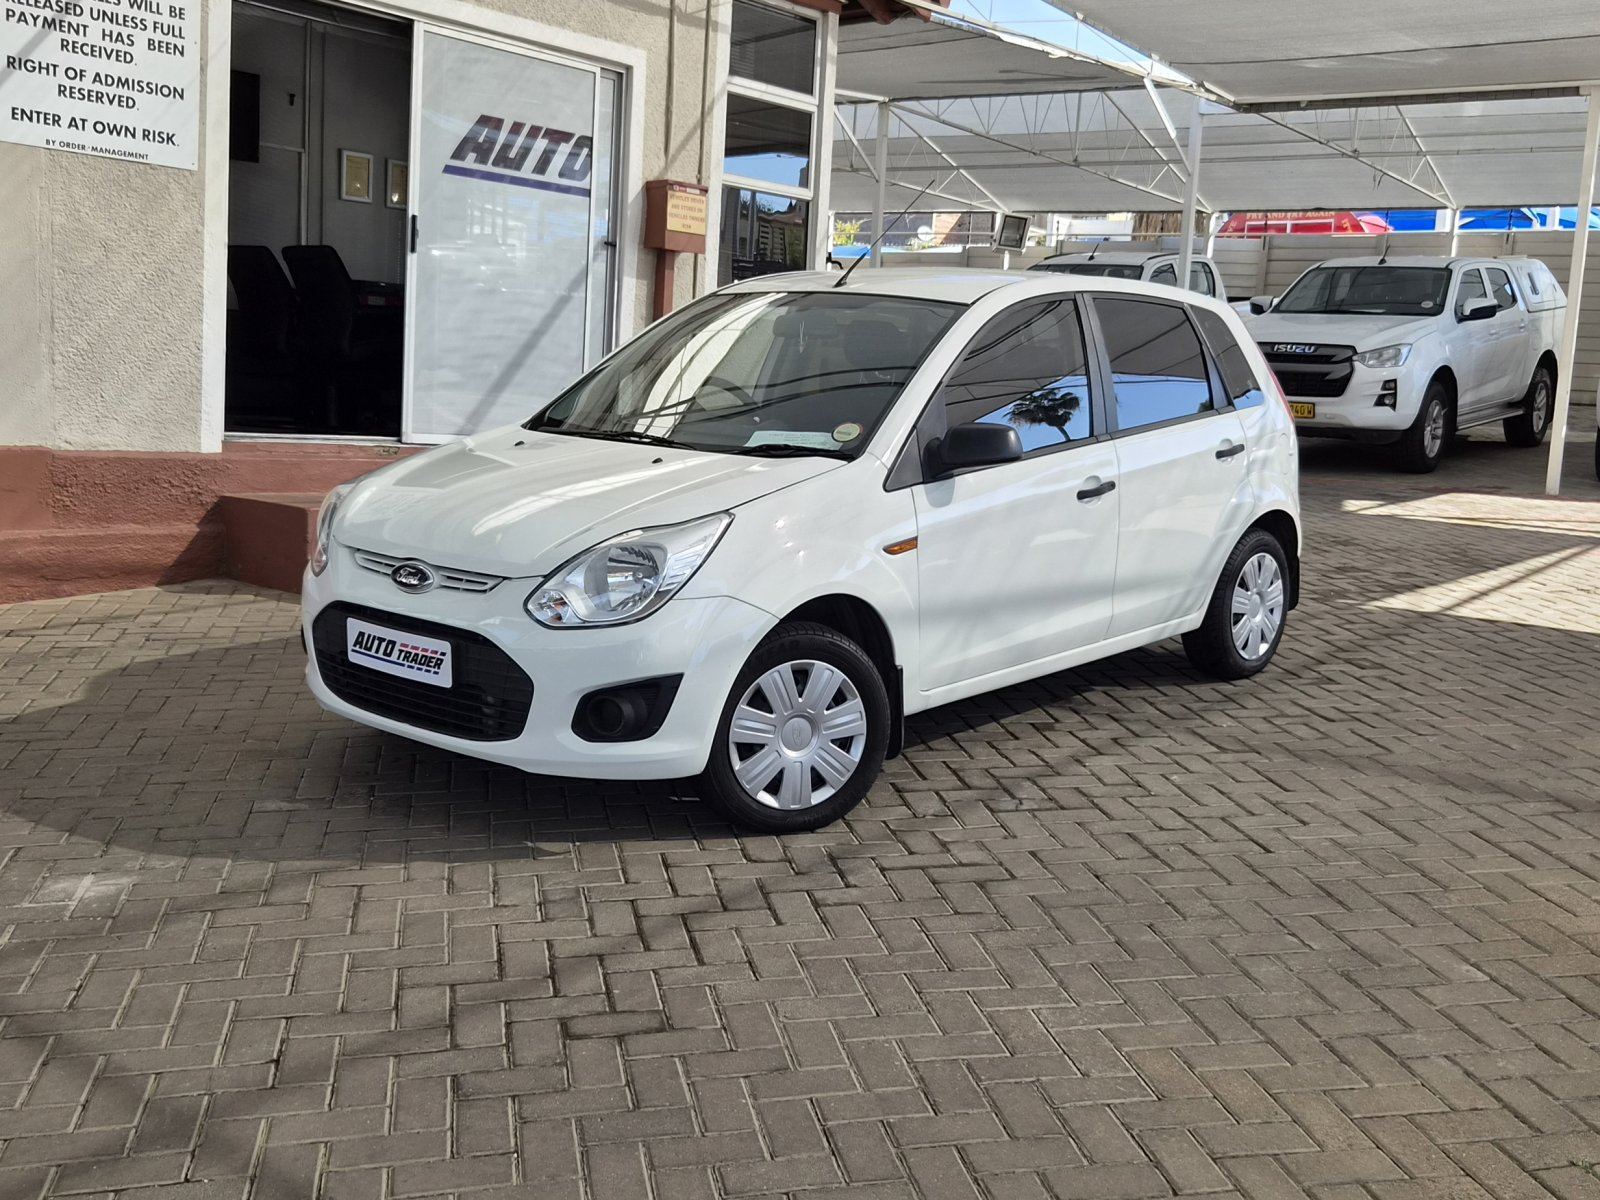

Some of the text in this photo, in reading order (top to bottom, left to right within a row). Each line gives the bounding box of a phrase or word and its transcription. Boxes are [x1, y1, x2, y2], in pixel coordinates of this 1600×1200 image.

[90, 7, 147, 31] UNLESS
[153, 21, 185, 40] FULL
[127, 0, 185, 20] WILL BE
[6, 8, 185, 57] PAYMENT HAS BEEN
[60, 38, 137, 66] RECEIVED.
[7, 55, 184, 101] RIGHT OF ADMISSION
[57, 83, 139, 110] RESERVED.
[11, 106, 180, 147] ENTER AT OWN RISK.
[45, 138, 56, 146] BY
[90, 145, 149, 161] MANAGEMENT
[450, 114, 593, 182] AUTO
[1273, 344, 1315, 353] ISUZU
[396, 567, 421, 584] Ford
[352, 631, 445, 670] AUTO TRADER
